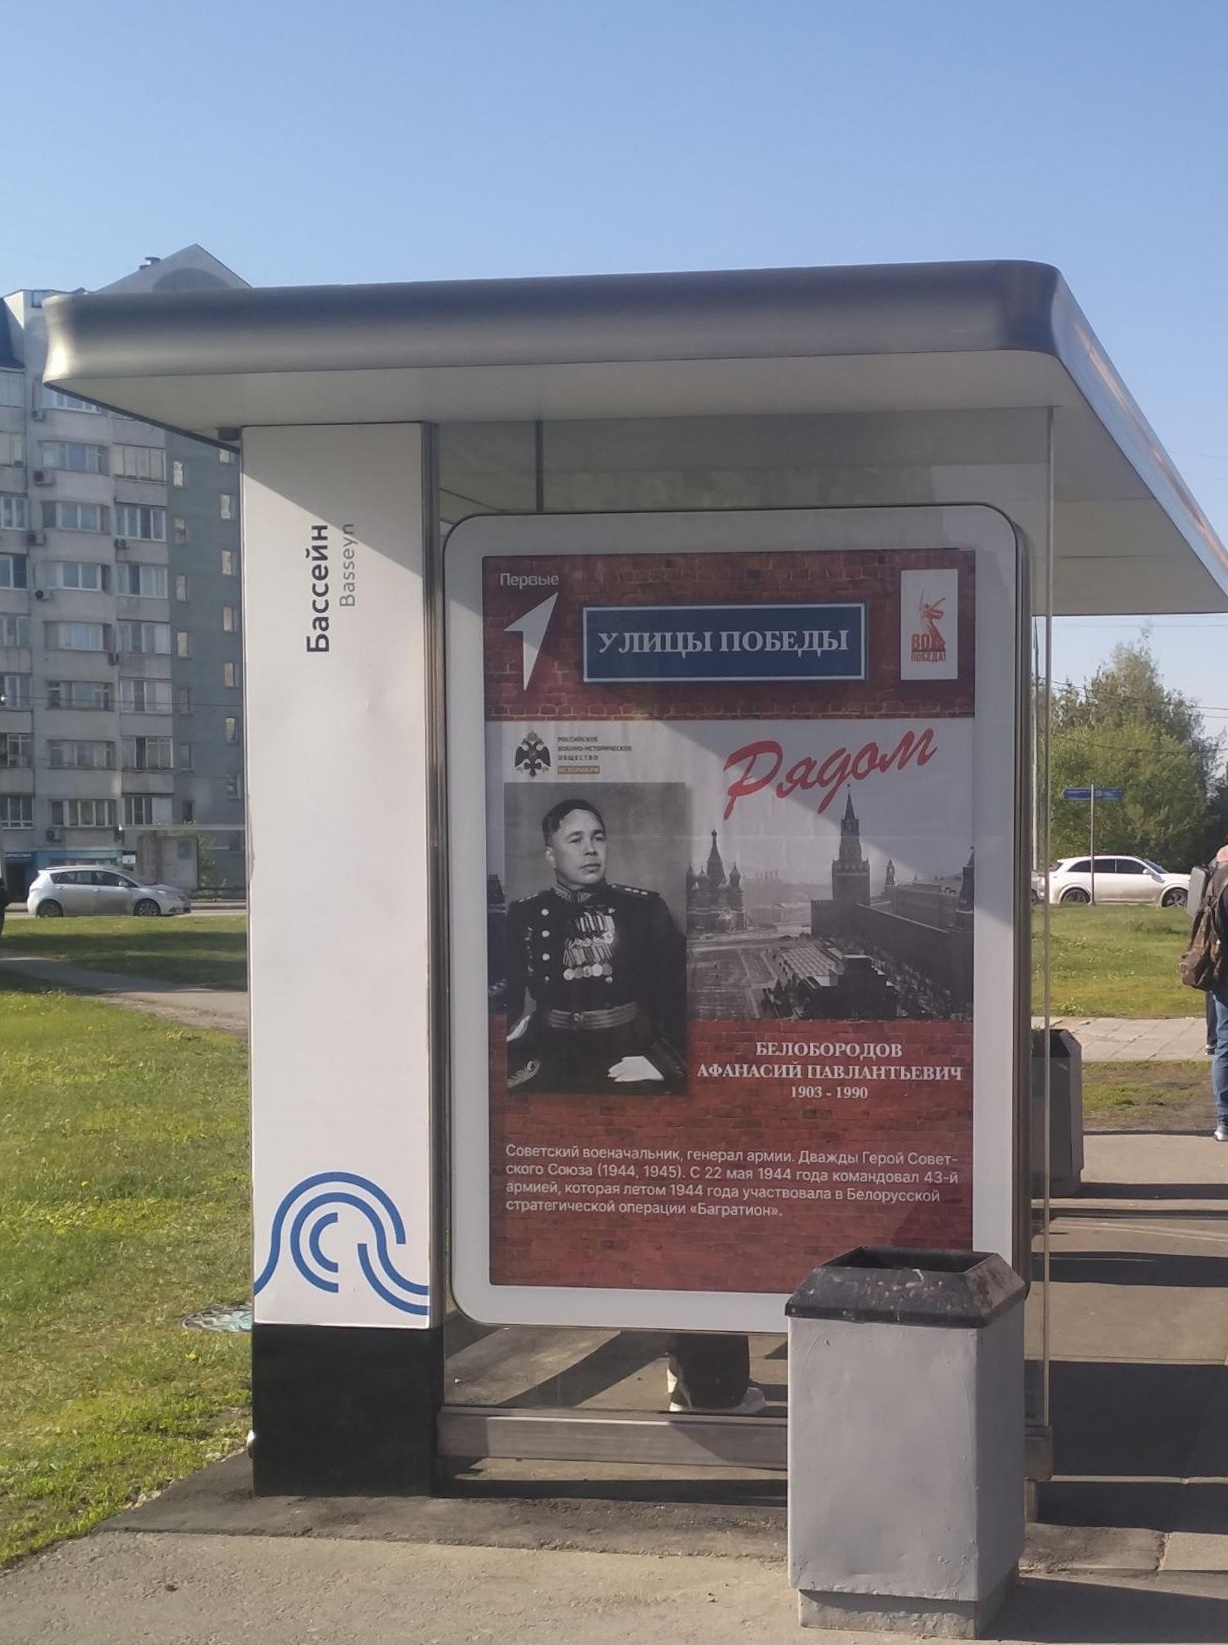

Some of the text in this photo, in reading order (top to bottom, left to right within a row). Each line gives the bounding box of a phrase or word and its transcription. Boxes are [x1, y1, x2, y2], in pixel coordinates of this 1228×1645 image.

[340, 523, 358, 608] Basseyn
[304, 525, 329, 653] Бассейн
[500, 572, 559, 589] Первые
[597, 629, 850, 659] УЛИЦЫ ПОБЕДЫ
[911, 651, 946, 664] ПОБЕДА!
[557, 736, 599, 744] РОССИЙСКОЕ
[722, 727, 938, 821] Рядом
[755, 1041, 902, 1060] БЕЛОБОРОДОВ
[696, 1061, 963, 1081] АФАНАСИЙ ПАВЛАНТЬЕВИЧ
[790, 1086, 823, 1099] 1903
[836, 1086, 869, 1099] 1990
[505, 1144, 958, 1166] Советский военачальник, генерал армии. Дважды Герой Совет-
[505, 1163, 959, 1184] ского Союза (1944, 1945). С 22 мая 1944 года командовал 43-й
[505, 1181, 941, 1203] армией, которая летом 1944 года участвовала в Белорусской
[505, 1199, 783, 1218] стратегической операции «Багратион».
